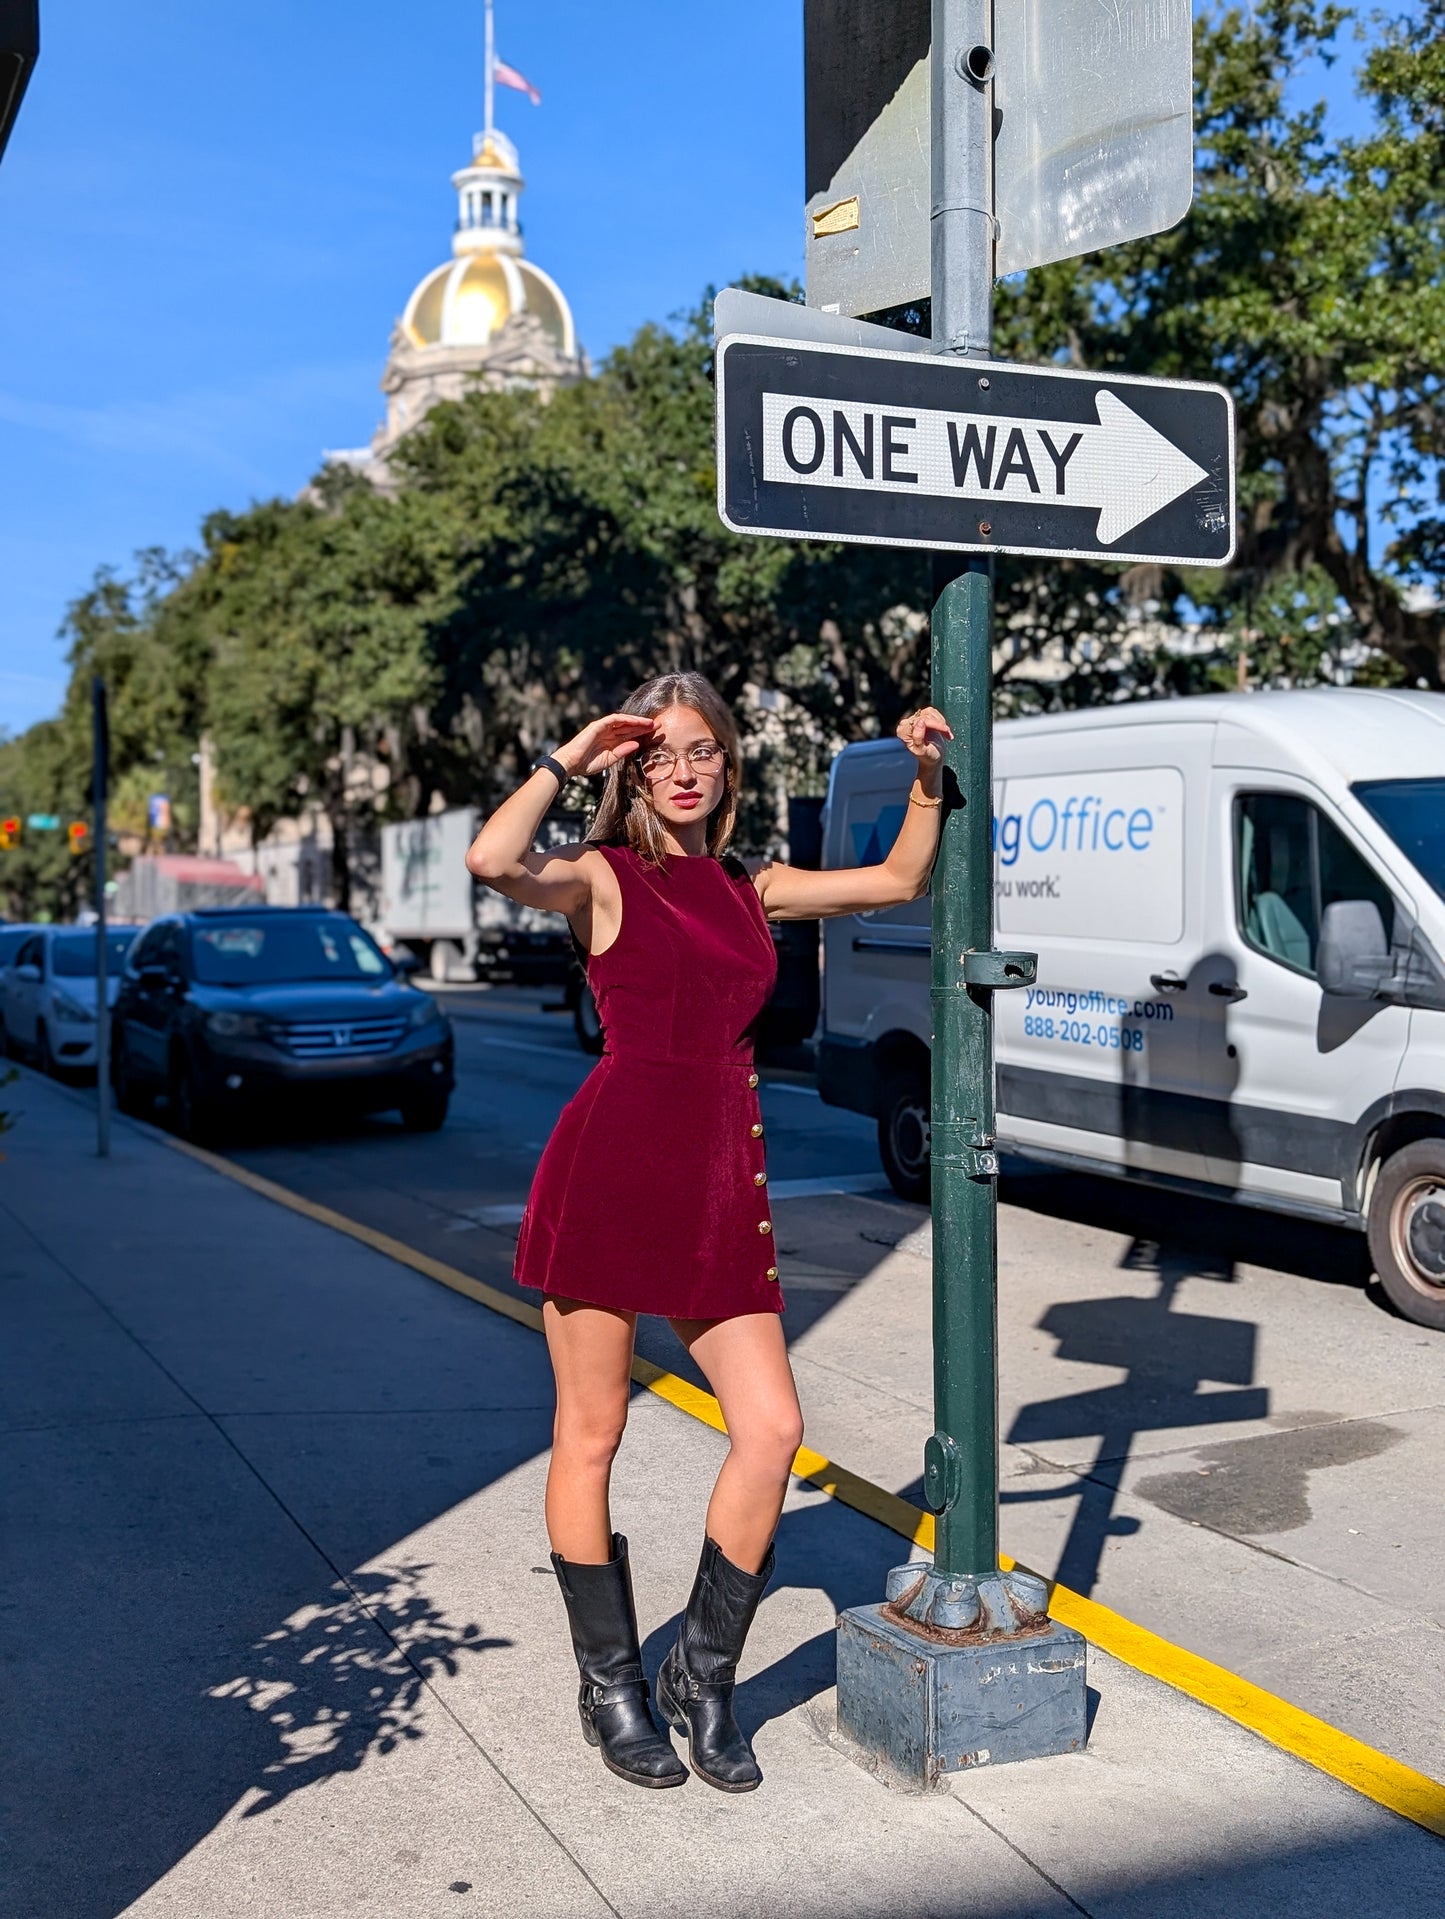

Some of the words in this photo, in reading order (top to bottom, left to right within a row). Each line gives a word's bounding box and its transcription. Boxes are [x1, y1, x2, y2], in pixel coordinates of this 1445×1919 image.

[782, 406, 918, 484] ONE
[947, 421, 1084, 495] WAY
[1025, 988, 1174, 1021] youngoffice.com
[1024, 1016, 1143, 1051] 888-202-0508
